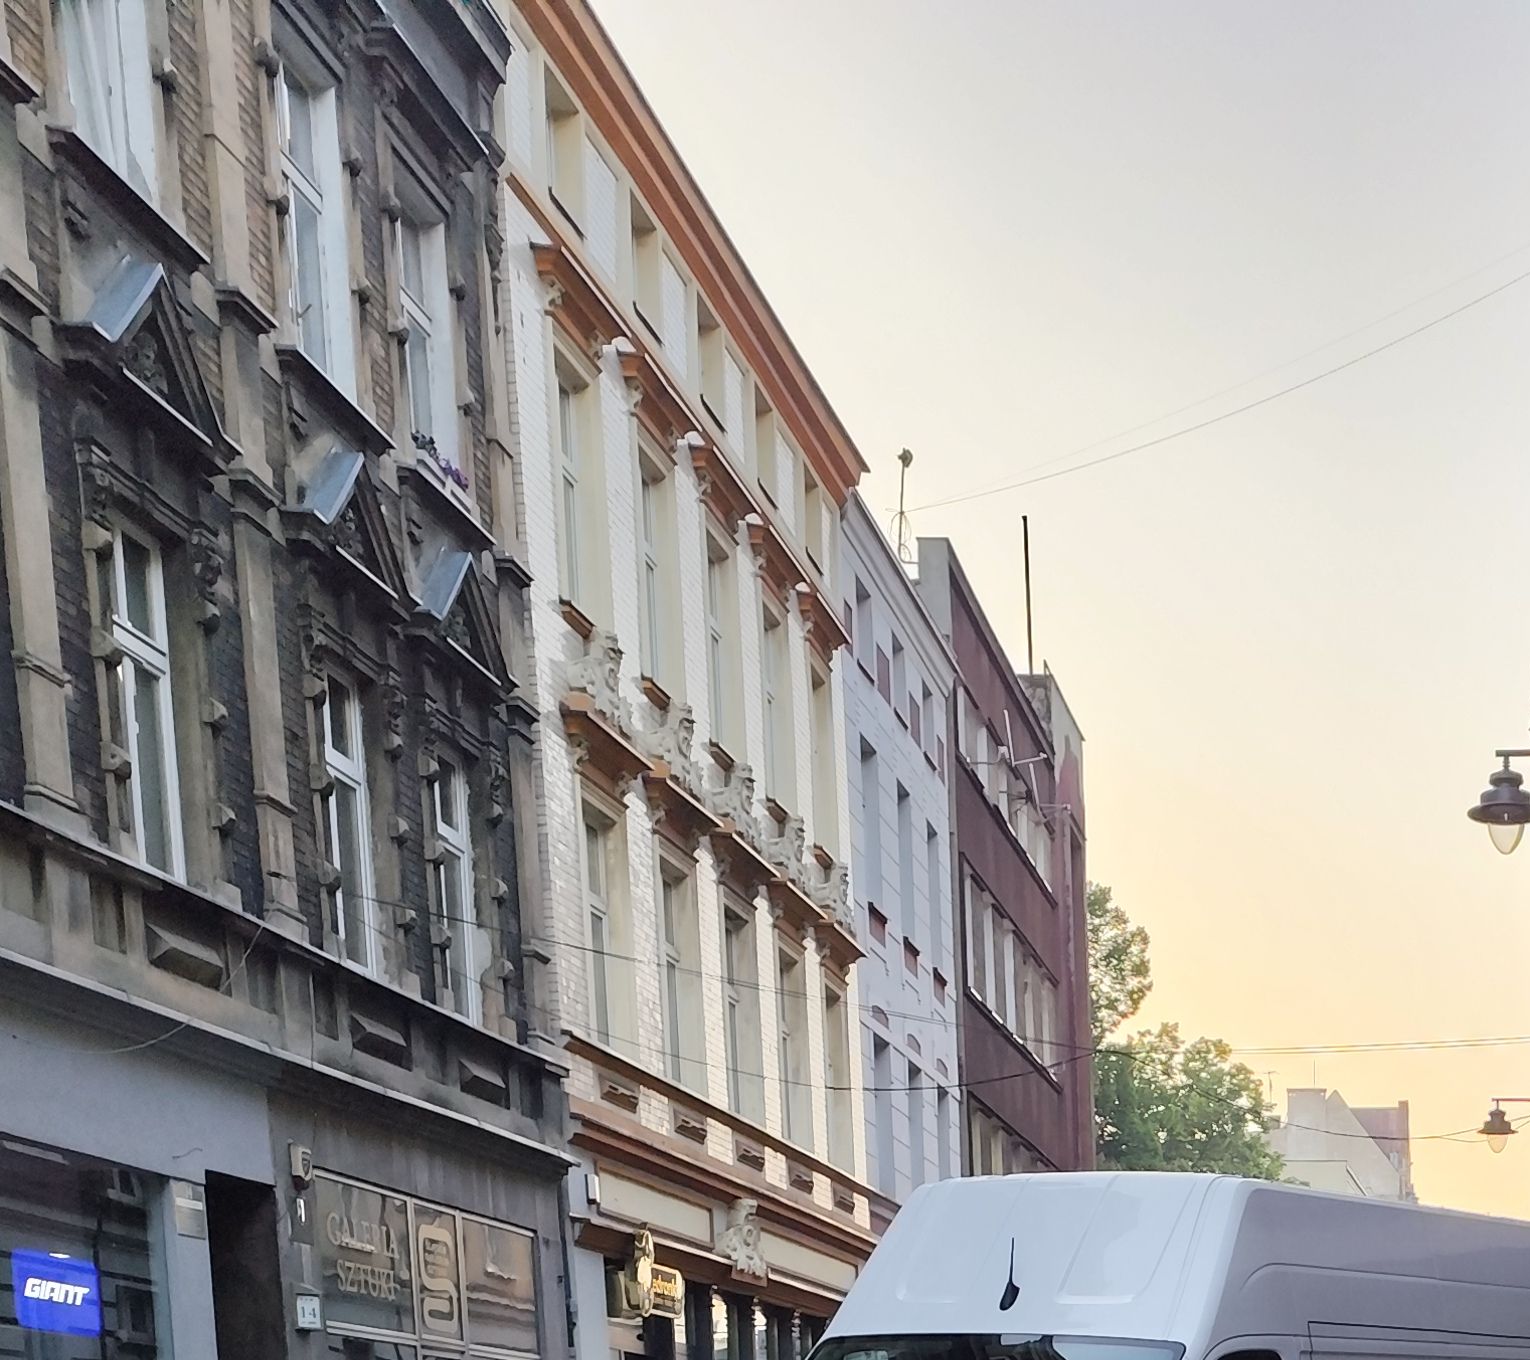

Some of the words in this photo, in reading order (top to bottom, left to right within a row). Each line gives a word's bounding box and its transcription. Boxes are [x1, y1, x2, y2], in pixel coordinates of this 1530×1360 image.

[327, 1212, 399, 1259] GALERIA
[24, 1278, 90, 1305] GIANT
[336, 1259, 396, 1300] SZTUKI
[301, 1305, 317, 1319] 14
